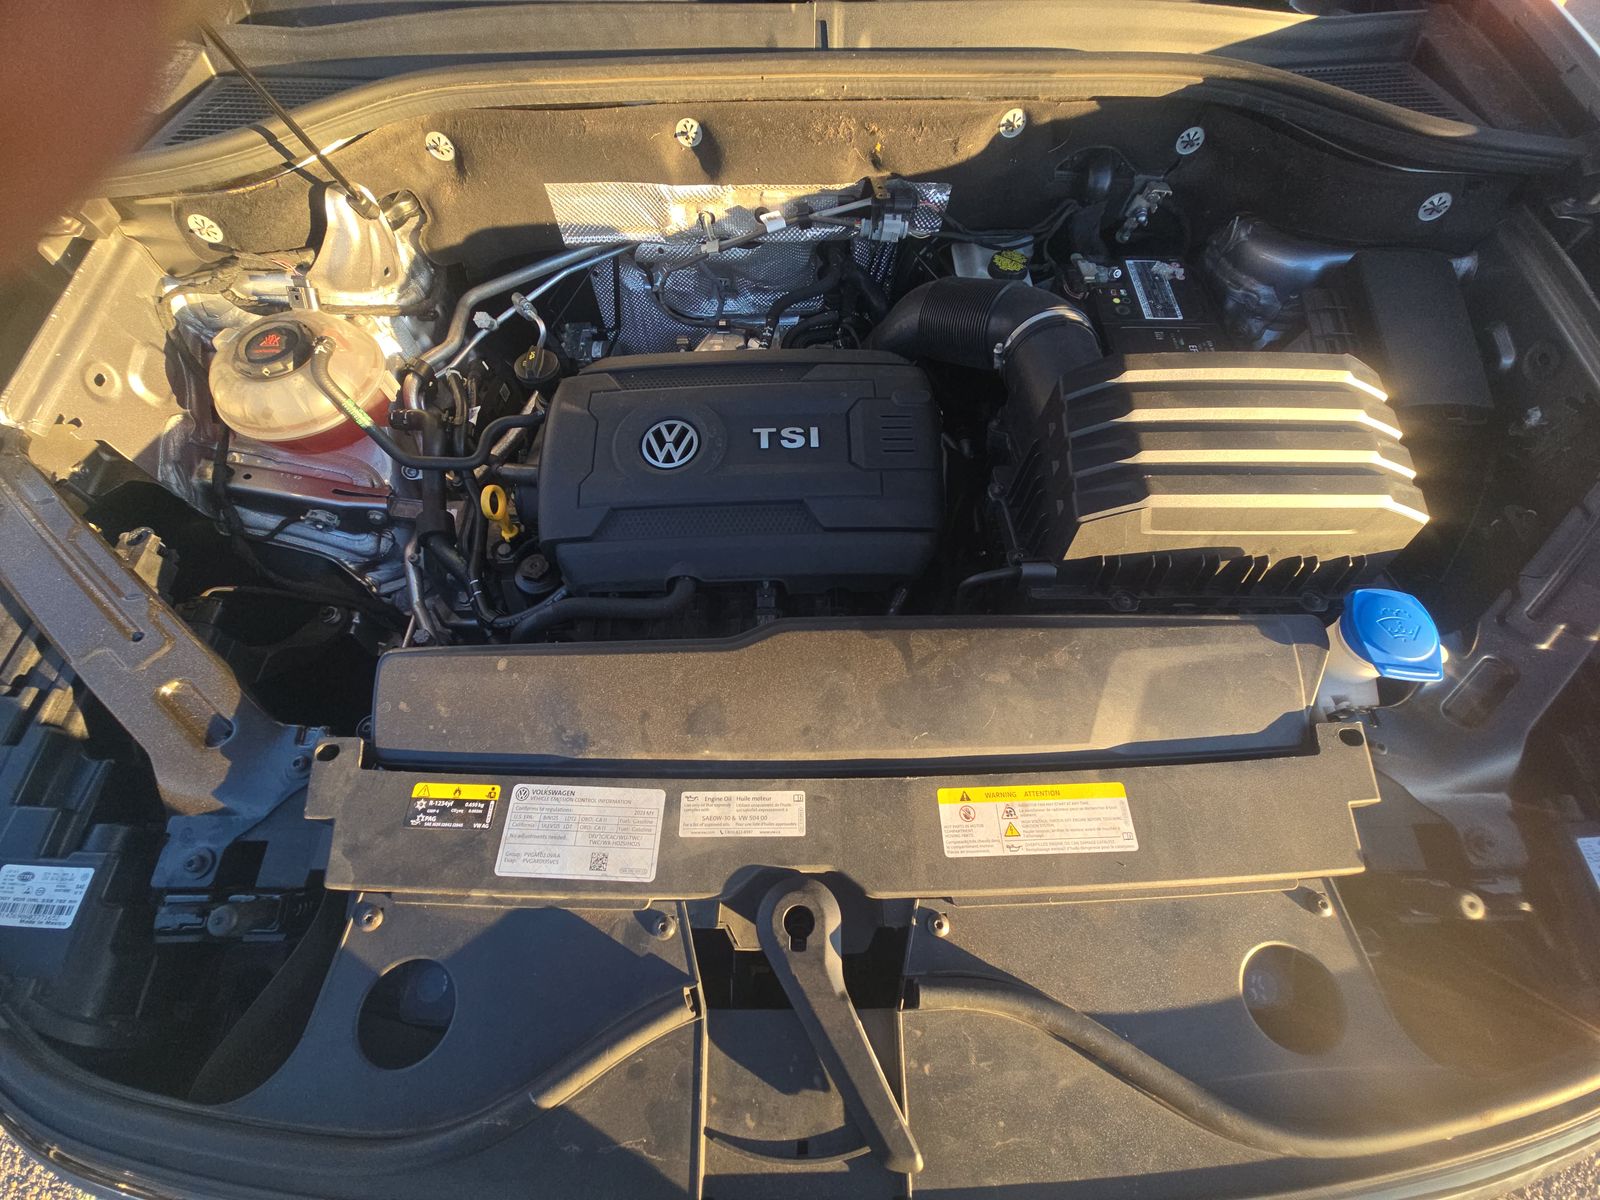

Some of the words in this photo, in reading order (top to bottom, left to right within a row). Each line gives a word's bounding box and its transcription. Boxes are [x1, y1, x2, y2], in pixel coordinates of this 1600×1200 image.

[752, 426, 820, 449] TSI
[531, 788, 576, 797] VOLKSWAGEN
[984, 791, 1017, 799] WARNING
[1024, 789, 1061, 797] ATTENTION
[428, 800, 454, 809] R-1234yf
